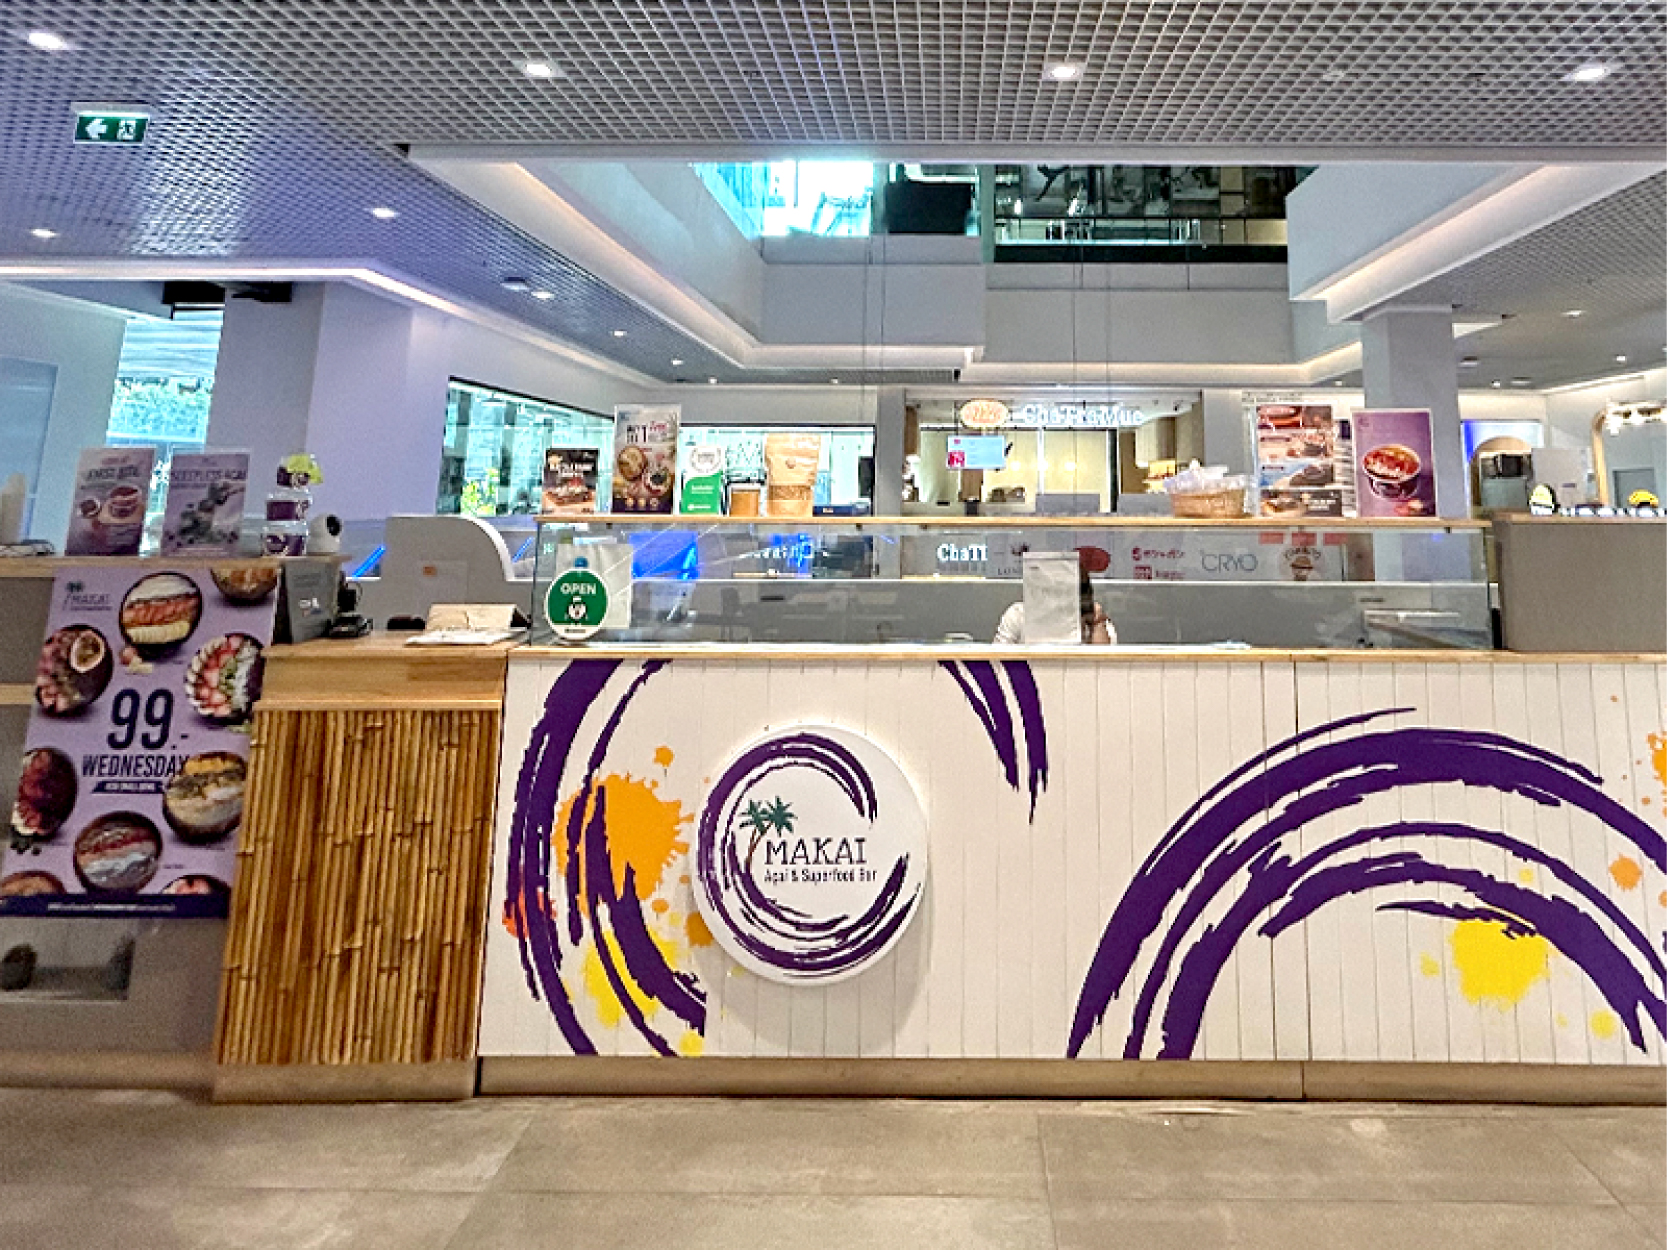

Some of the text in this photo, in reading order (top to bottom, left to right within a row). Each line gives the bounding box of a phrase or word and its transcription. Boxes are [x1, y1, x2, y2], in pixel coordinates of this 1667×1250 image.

[1201, 553, 1259, 573] CRYO
[559, 582, 597, 595] OPEN
[81, 753, 190, 778] WEDNESDAY
[764, 837, 868, 865] MAKAI
[791, 870, 799, 882] &
[801, 869, 855, 886] Superfood
[860, 868, 878, 882] Bar
